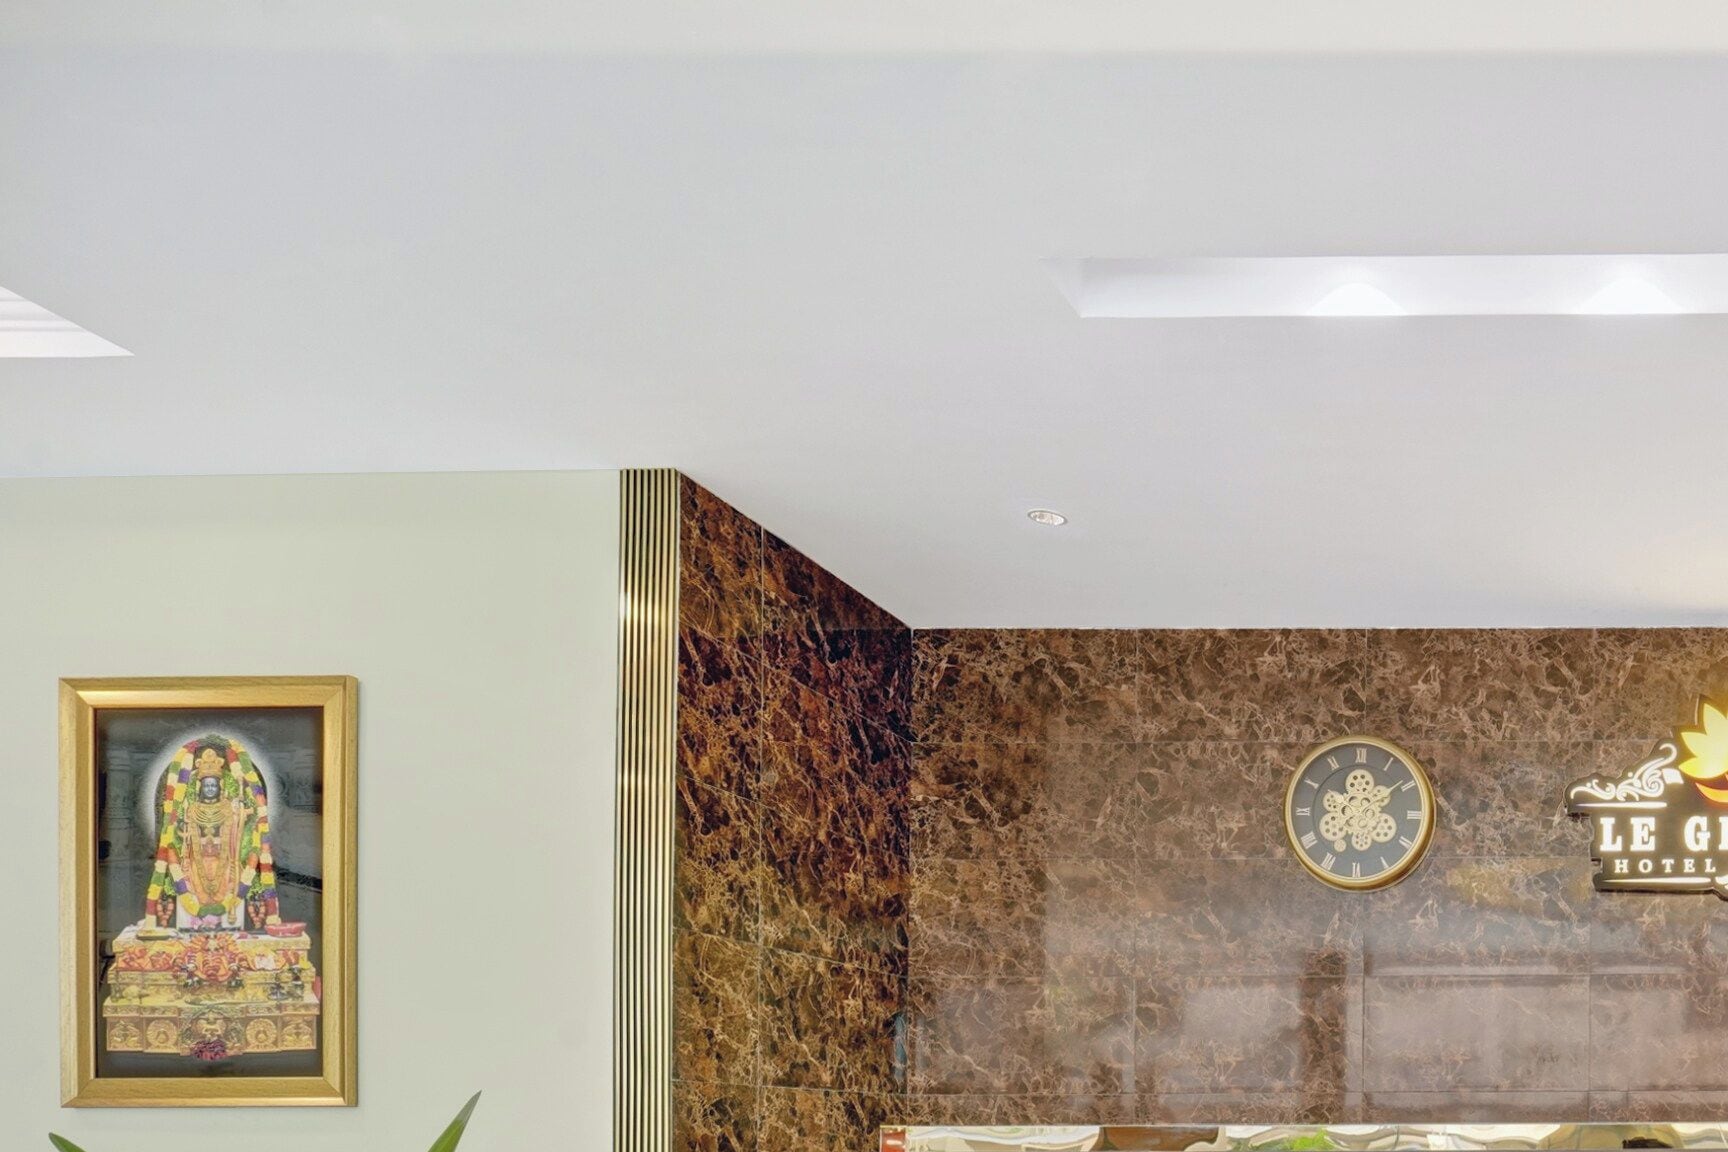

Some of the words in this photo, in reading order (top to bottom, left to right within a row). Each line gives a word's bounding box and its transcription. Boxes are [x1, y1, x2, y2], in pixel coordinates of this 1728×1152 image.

[1356, 748, 1366, 763] XII
[1599, 816, 1656, 851] LE
[1614, 859, 1716, 873] HOTEL
